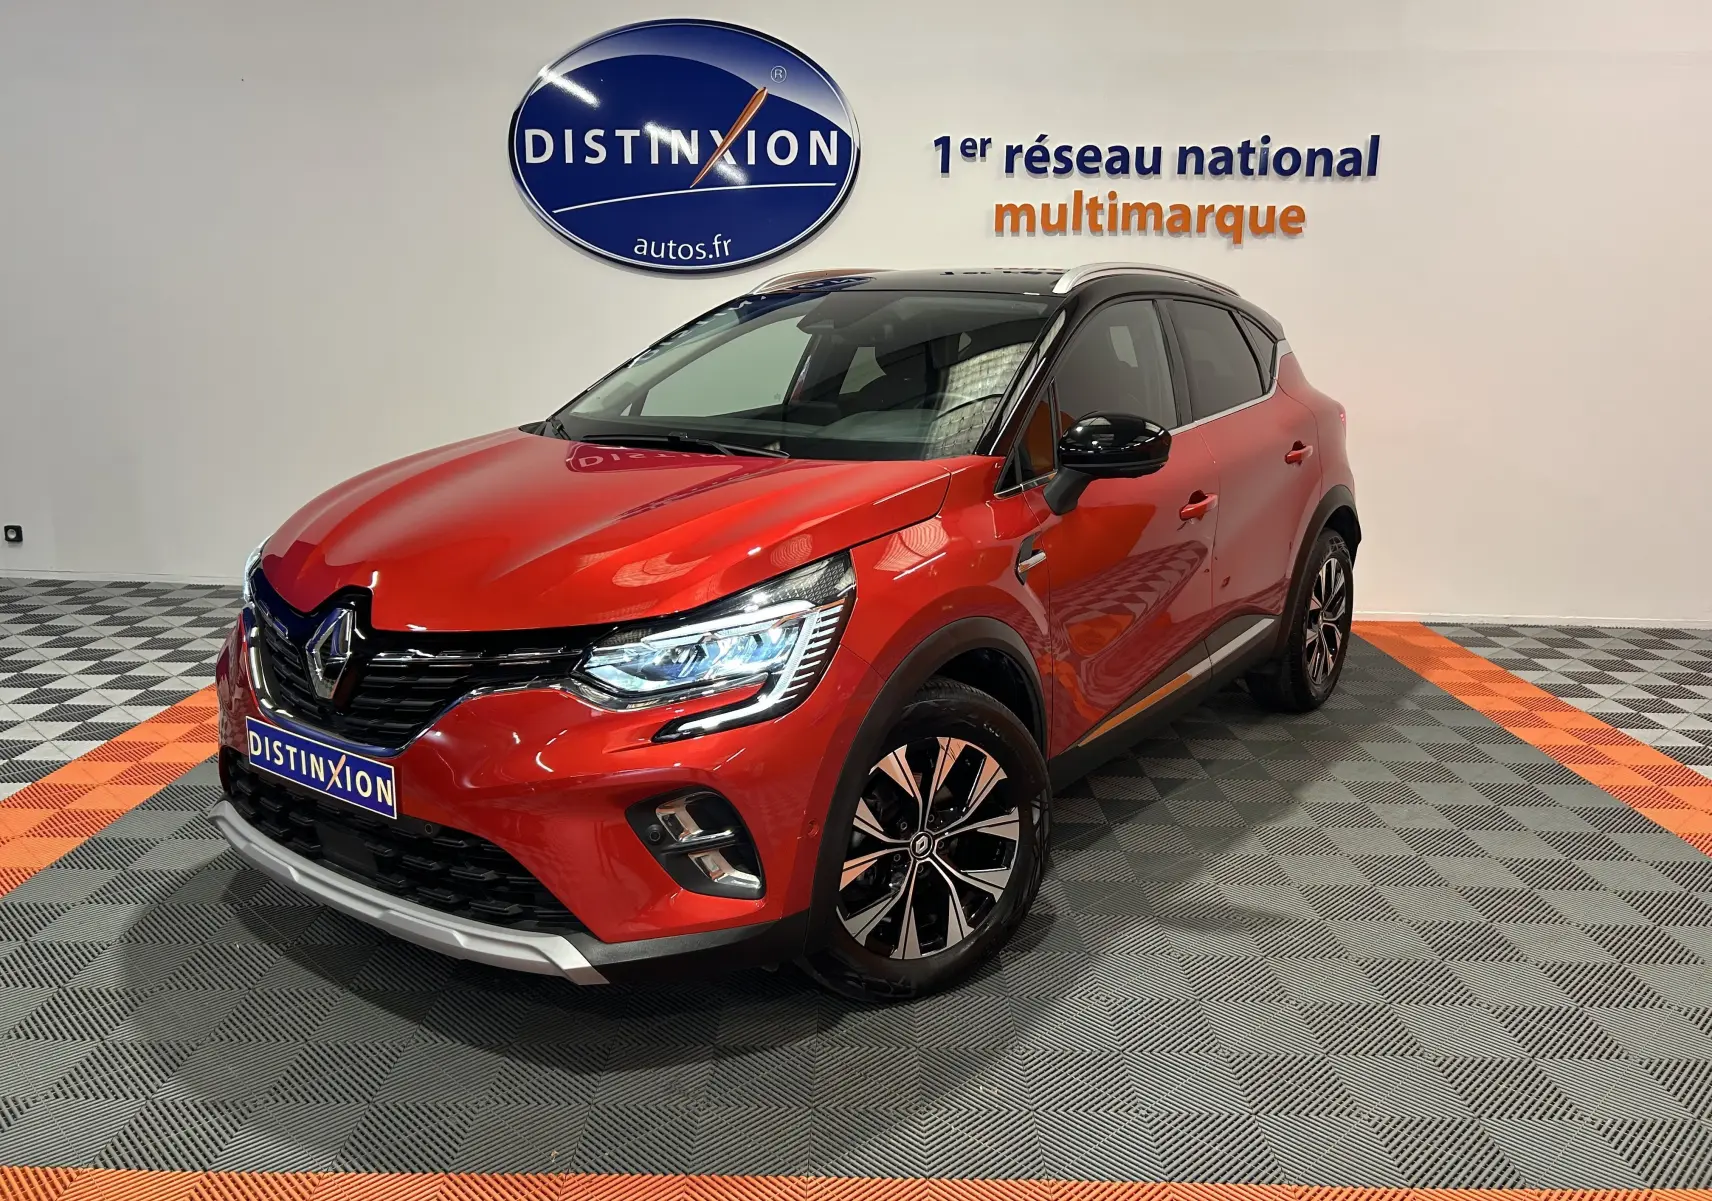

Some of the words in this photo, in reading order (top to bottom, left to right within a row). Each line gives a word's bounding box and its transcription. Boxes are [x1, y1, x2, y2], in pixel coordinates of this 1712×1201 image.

[524, 129, 838, 166] DISTINXION
[1004, 133, 1162, 175] réseau
[1176, 134, 1381, 177] national
[994, 190, 1307, 245] multimarque
[633, 233, 732, 260] autos.fr
[249, 730, 393, 807] DISTINXION
